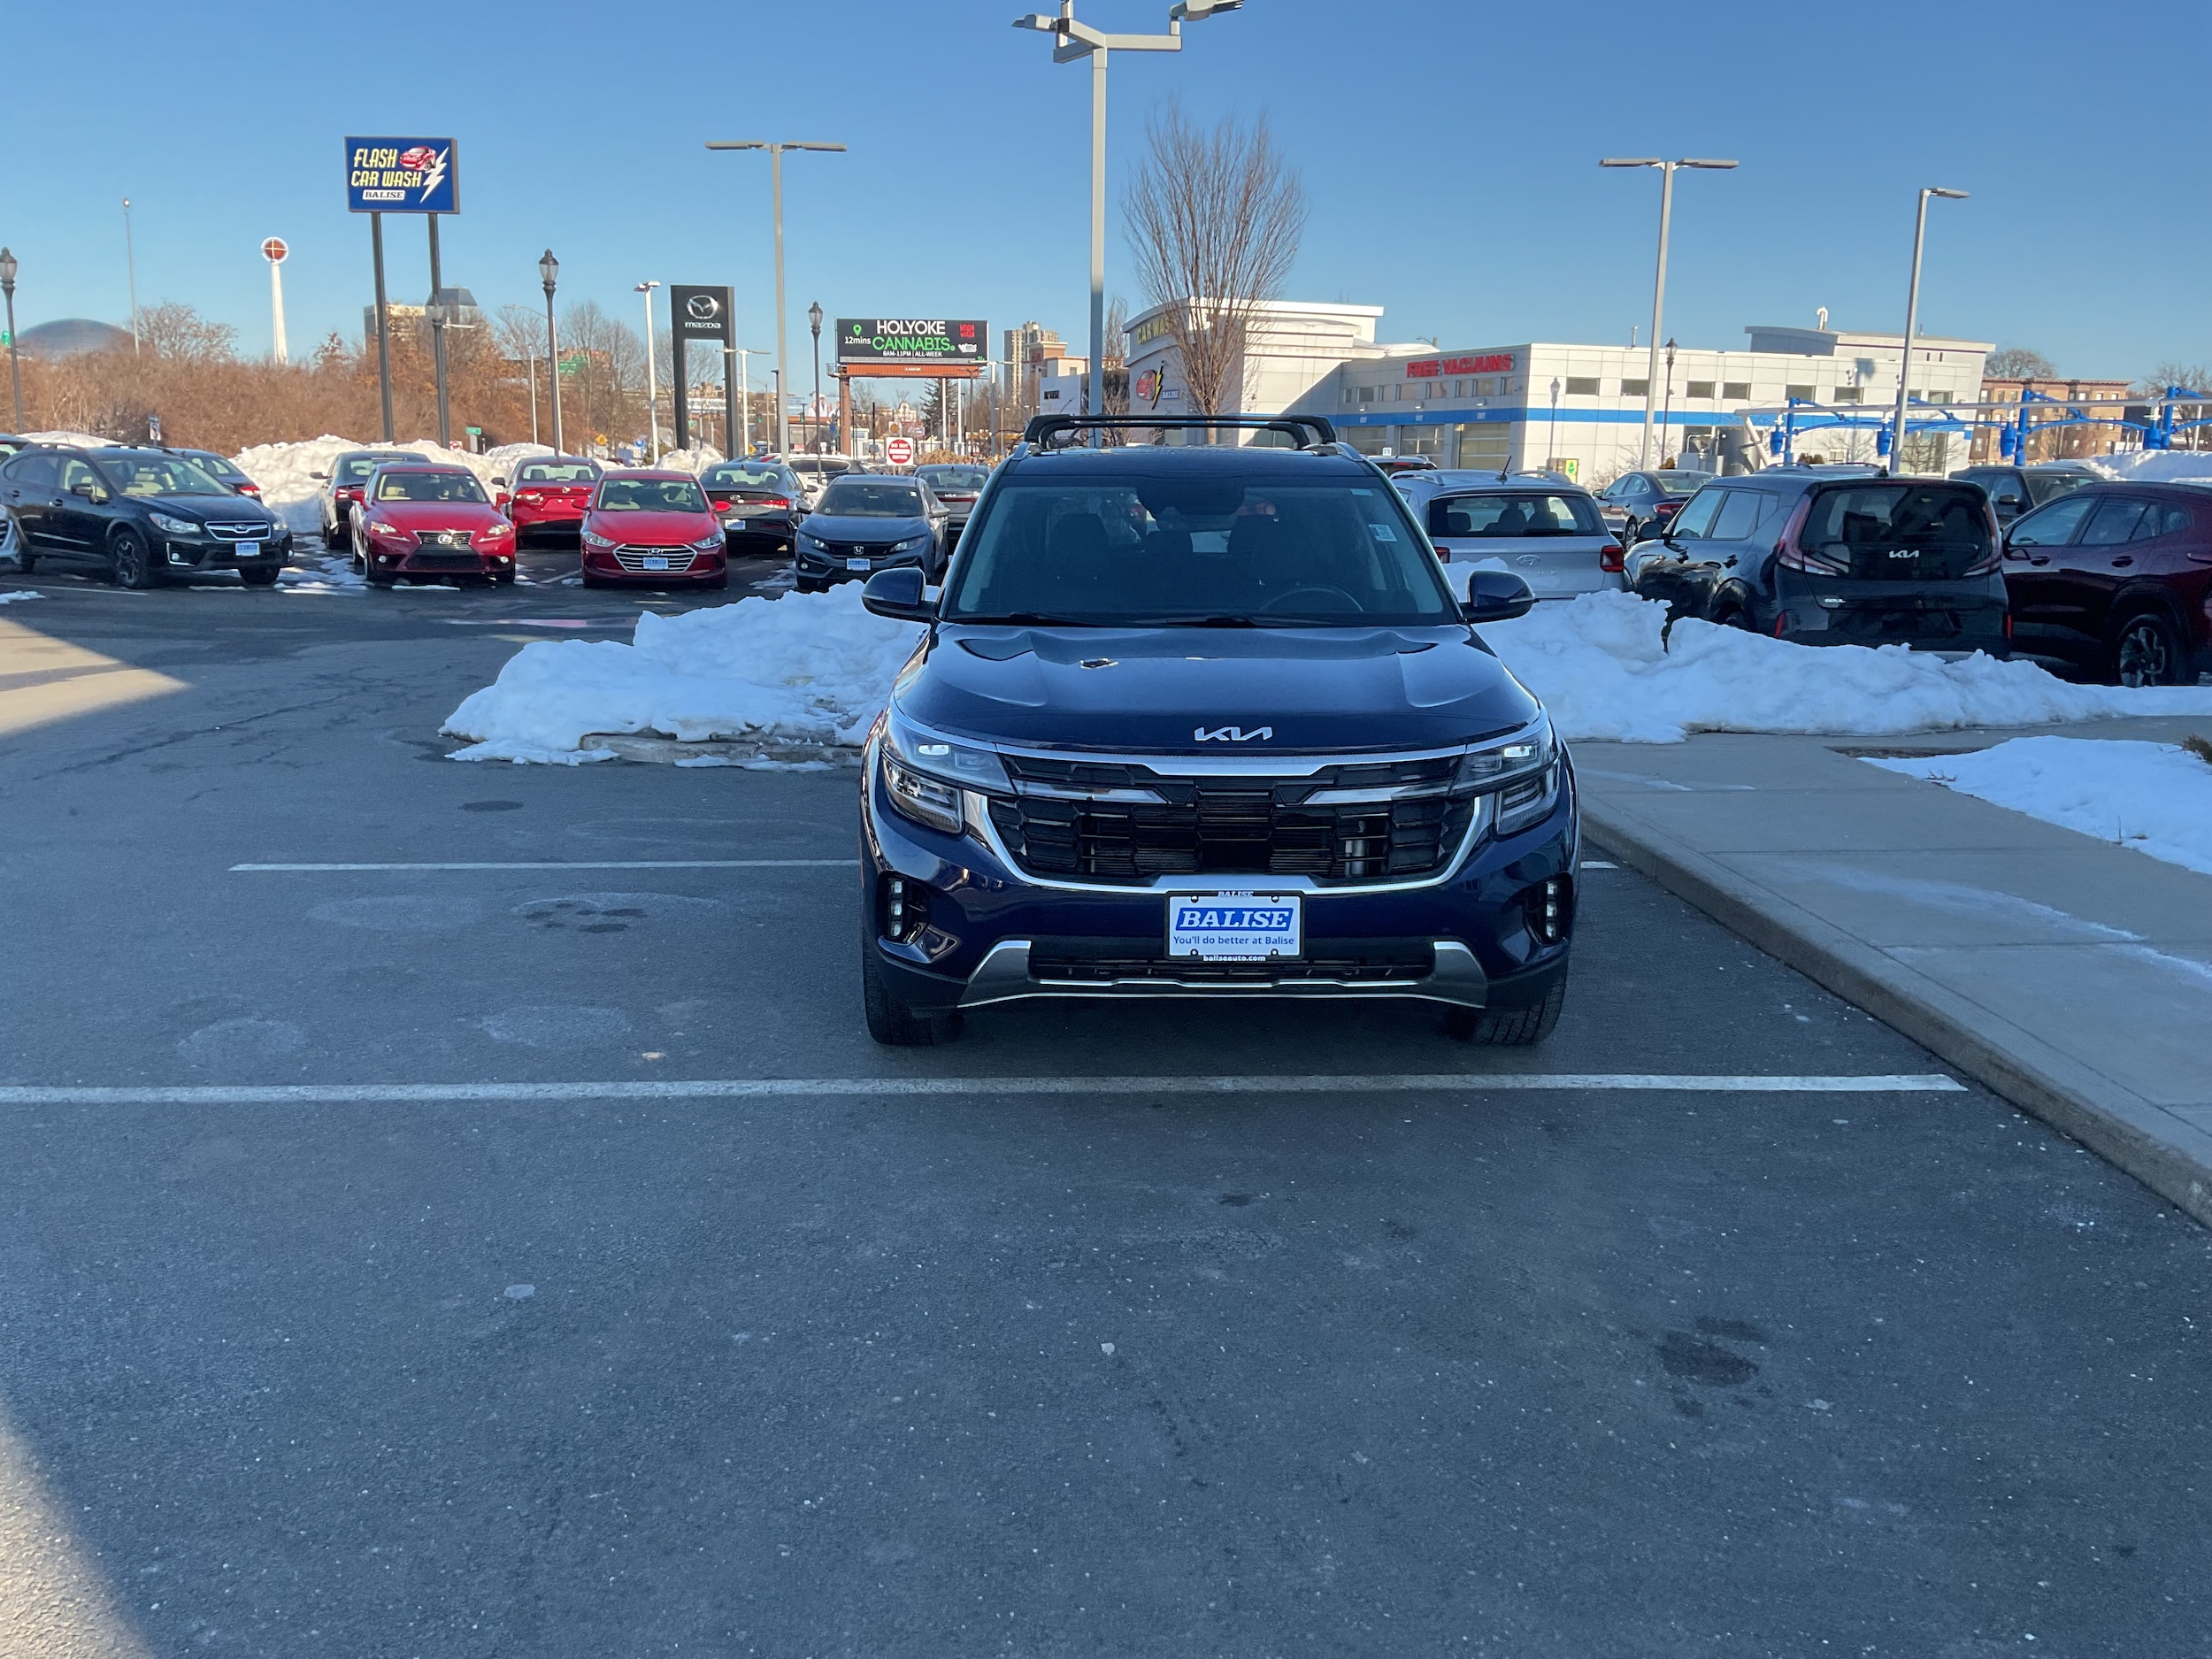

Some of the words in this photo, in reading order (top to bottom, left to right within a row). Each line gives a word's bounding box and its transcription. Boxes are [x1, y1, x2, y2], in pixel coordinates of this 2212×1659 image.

[354, 149, 398, 168] FLASH
[351, 171, 380, 187] CAR
[381, 171, 422, 187] WASH
[876, 319, 946, 335] HOLYOKE
[1137, 324, 1151, 344] CAR
[1153, 316, 1173, 337] WAS
[844, 336, 872, 345] 12mins
[1407, 360, 1439, 378] FREE
[1442, 354, 1512, 375] VACUUMS
[1888, 549, 1920, 558] KIA
[1194, 726, 1273, 741] KIA
[1179, 910, 1290, 928] BALISE
[1173, 935, 1200, 945] You'll
[1202, 936, 1215, 945] do
[1217, 936, 1249, 945] better
[1265, 936, 1294, 945] Balise
